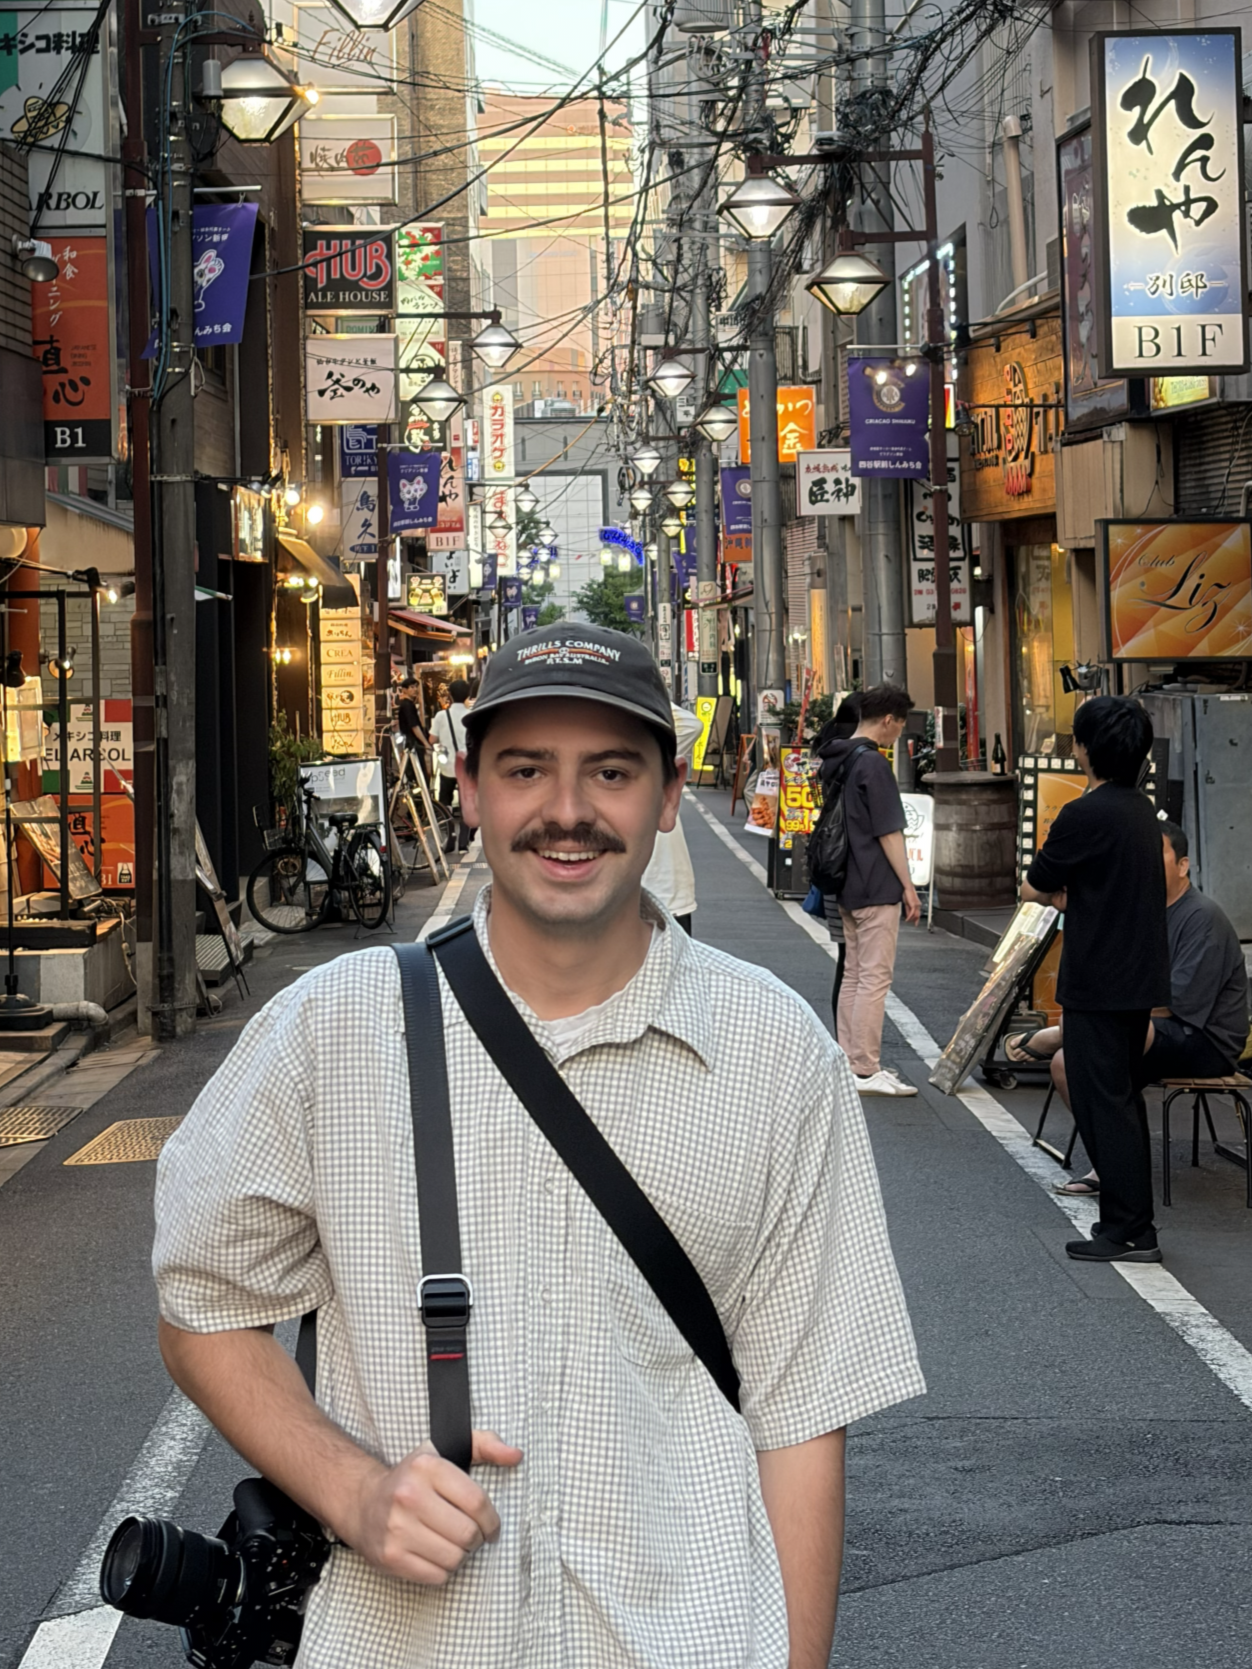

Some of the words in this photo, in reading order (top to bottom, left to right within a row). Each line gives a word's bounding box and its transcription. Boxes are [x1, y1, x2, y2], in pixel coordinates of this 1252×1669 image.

[1119, 55, 1226, 256] れんや
[62, 246, 78, 280] 和食
[304, 240, 391, 289] HUB
[307, 291, 335, 303] ALE
[339, 291, 389, 302] HOUSE
[1147, 272, 1208, 298] 別邸
[1133, 323, 1224, 359] B1F
[317, 370, 381, 402] 釜のや
[55, 427, 87, 448] B1
[490, 405, 506, 461] カラオケ
[808, 476, 857, 506] 匠神
[435, 535, 459, 548] B1F
[1138, 554, 1175, 567] Club
[1127, 551, 1231, 634] Liz
[517, 640, 561, 661] THRILLS
[565, 640, 621, 662] COMPANY
